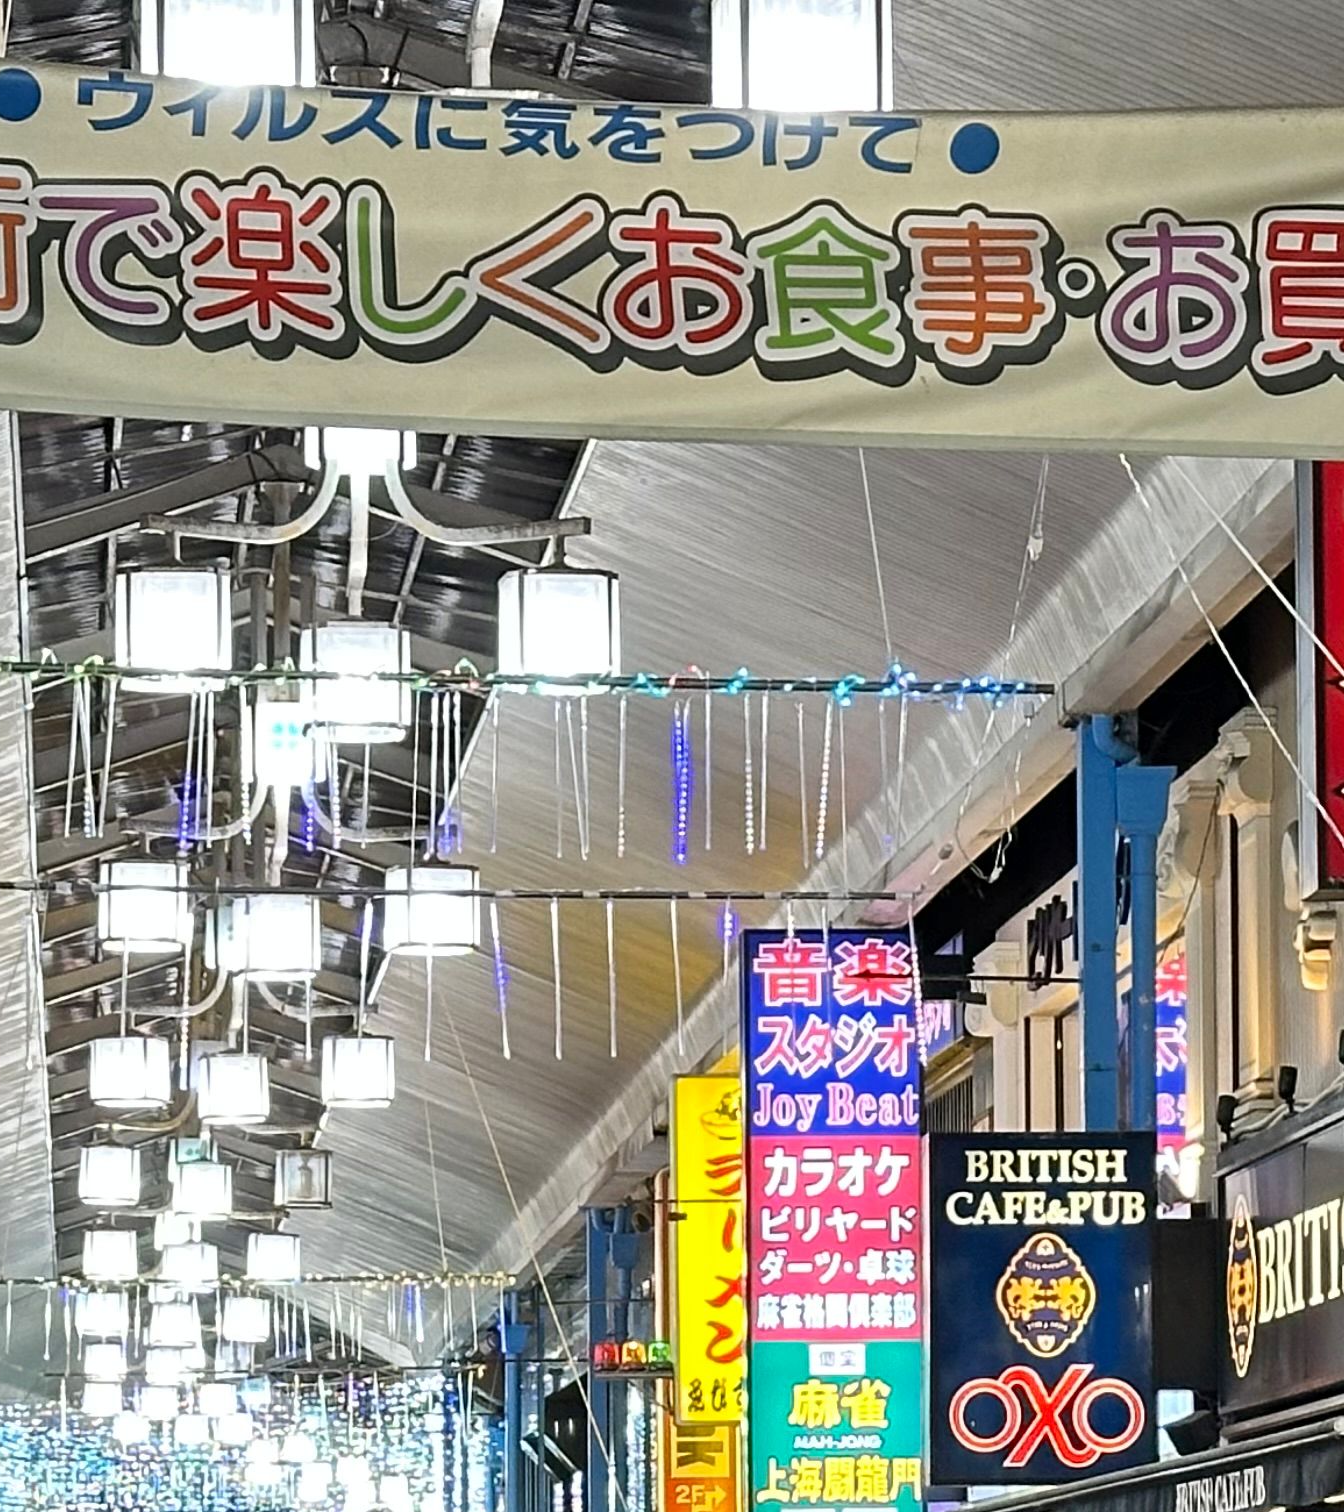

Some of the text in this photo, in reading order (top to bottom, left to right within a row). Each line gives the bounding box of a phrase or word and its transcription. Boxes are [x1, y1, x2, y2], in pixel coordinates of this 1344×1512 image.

[753, 938, 914, 1007] 音楽
[754, 1012, 916, 1079] スタジオ
[753, 1082, 920, 1132] Joy Beat
[763, 1146, 911, 1197] カラオケ
[965, 1149, 1128, 1183] BRITISH
[761, 1206, 917, 1243] ビリヤード
[945, 1191, 1146, 1226] CAFE&PUB
[759, 1248, 916, 1286] ダーツ・卓球
[787, 1378, 892, 1430] 麻雀
[948, 1363, 1146, 1468] OXO
